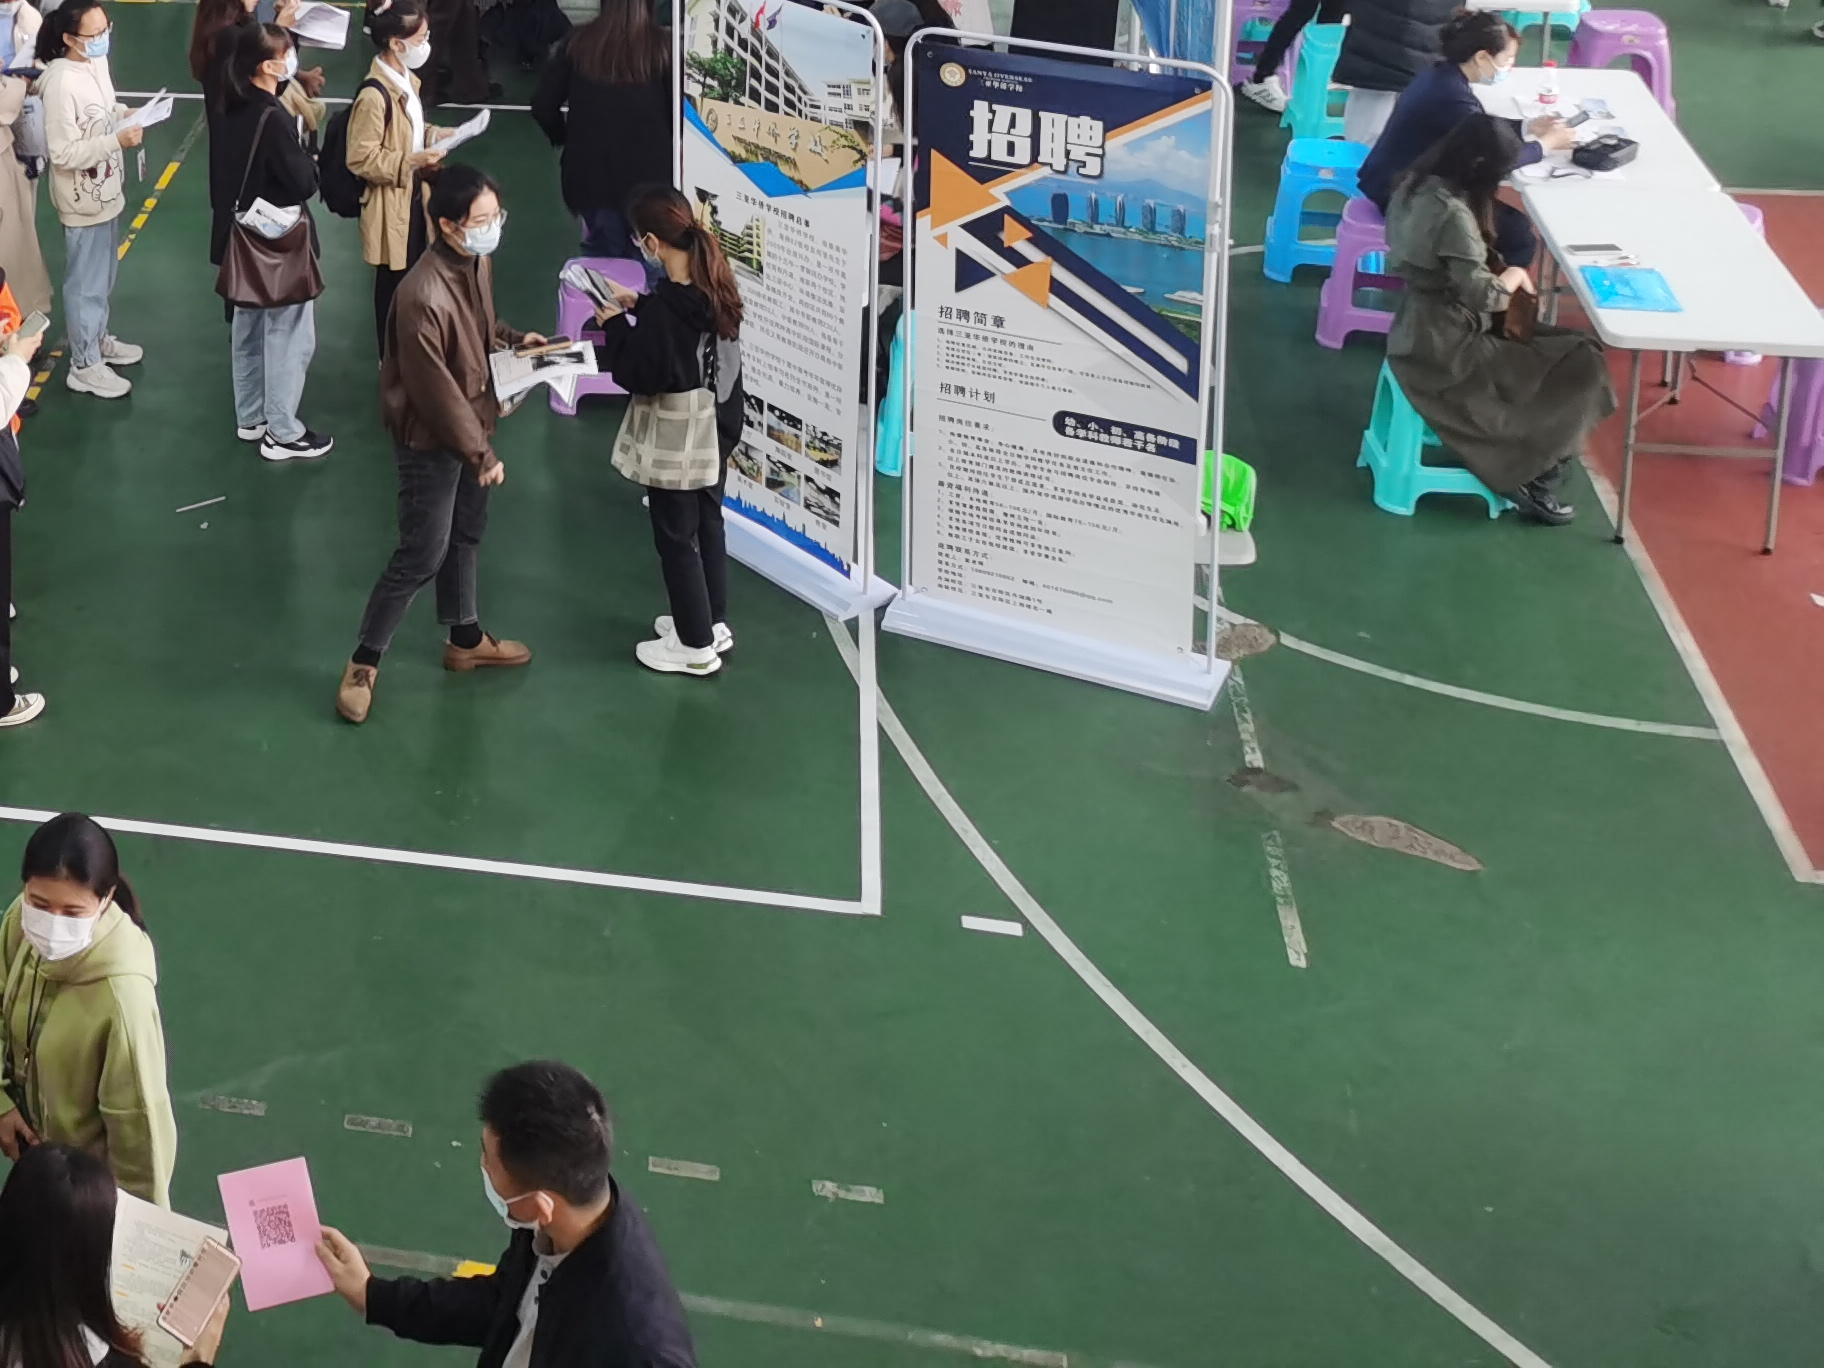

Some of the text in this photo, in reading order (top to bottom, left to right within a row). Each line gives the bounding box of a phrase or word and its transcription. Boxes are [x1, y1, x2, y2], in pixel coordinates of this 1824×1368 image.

[969, 99, 1105, 177] 招聘
[937, 305, 1007, 329] 招聘简章
[939, 381, 996, 404] 招聘计划
